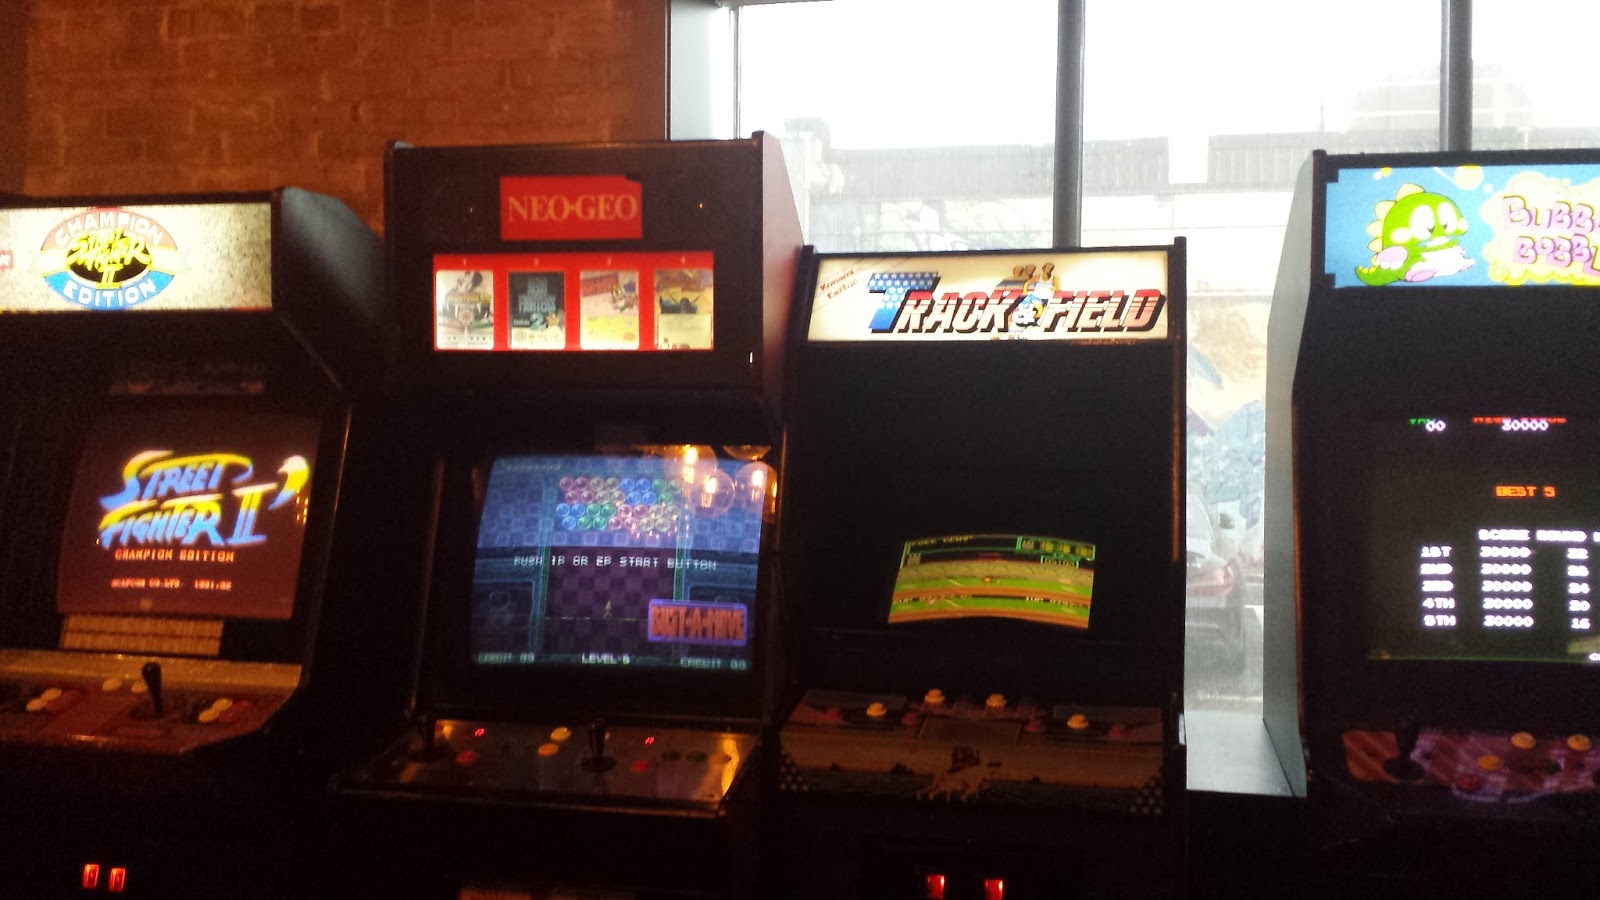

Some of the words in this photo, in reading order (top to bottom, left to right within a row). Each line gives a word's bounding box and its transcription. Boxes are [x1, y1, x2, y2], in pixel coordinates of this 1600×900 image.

[54, 211, 163, 247] CHAMPION
[63, 279, 156, 307] EDITION
[867, 271, 1022, 333] TRACK
[1039, 288, 1167, 333] FIELD
[1426, 419, 1447, 432] 00
[1502, 418, 1549, 431] 30000
[100, 450, 254, 511] STREET
[1495, 485, 1538, 498] BEST
[1542, 486, 1556, 498] 5
[98, 494, 226, 550] FIGHTER
[1478, 529, 1531, 541] SCORE
[115, 548, 173, 560] CHAMPION
[180, 549, 235, 562] EDITION
[1420, 546, 1452, 557] 1ST
[513, 555, 543, 567] PUSH
[551, 555, 566, 567] 1P
[573, 555, 588, 567] OR
[619, 556, 659, 568] START
[667, 556, 717, 570] BUTTON
[1422, 598, 1456, 609] 4TH
[1424, 615, 1457, 627] 5TH
[1571, 617, 1591, 629] 16
